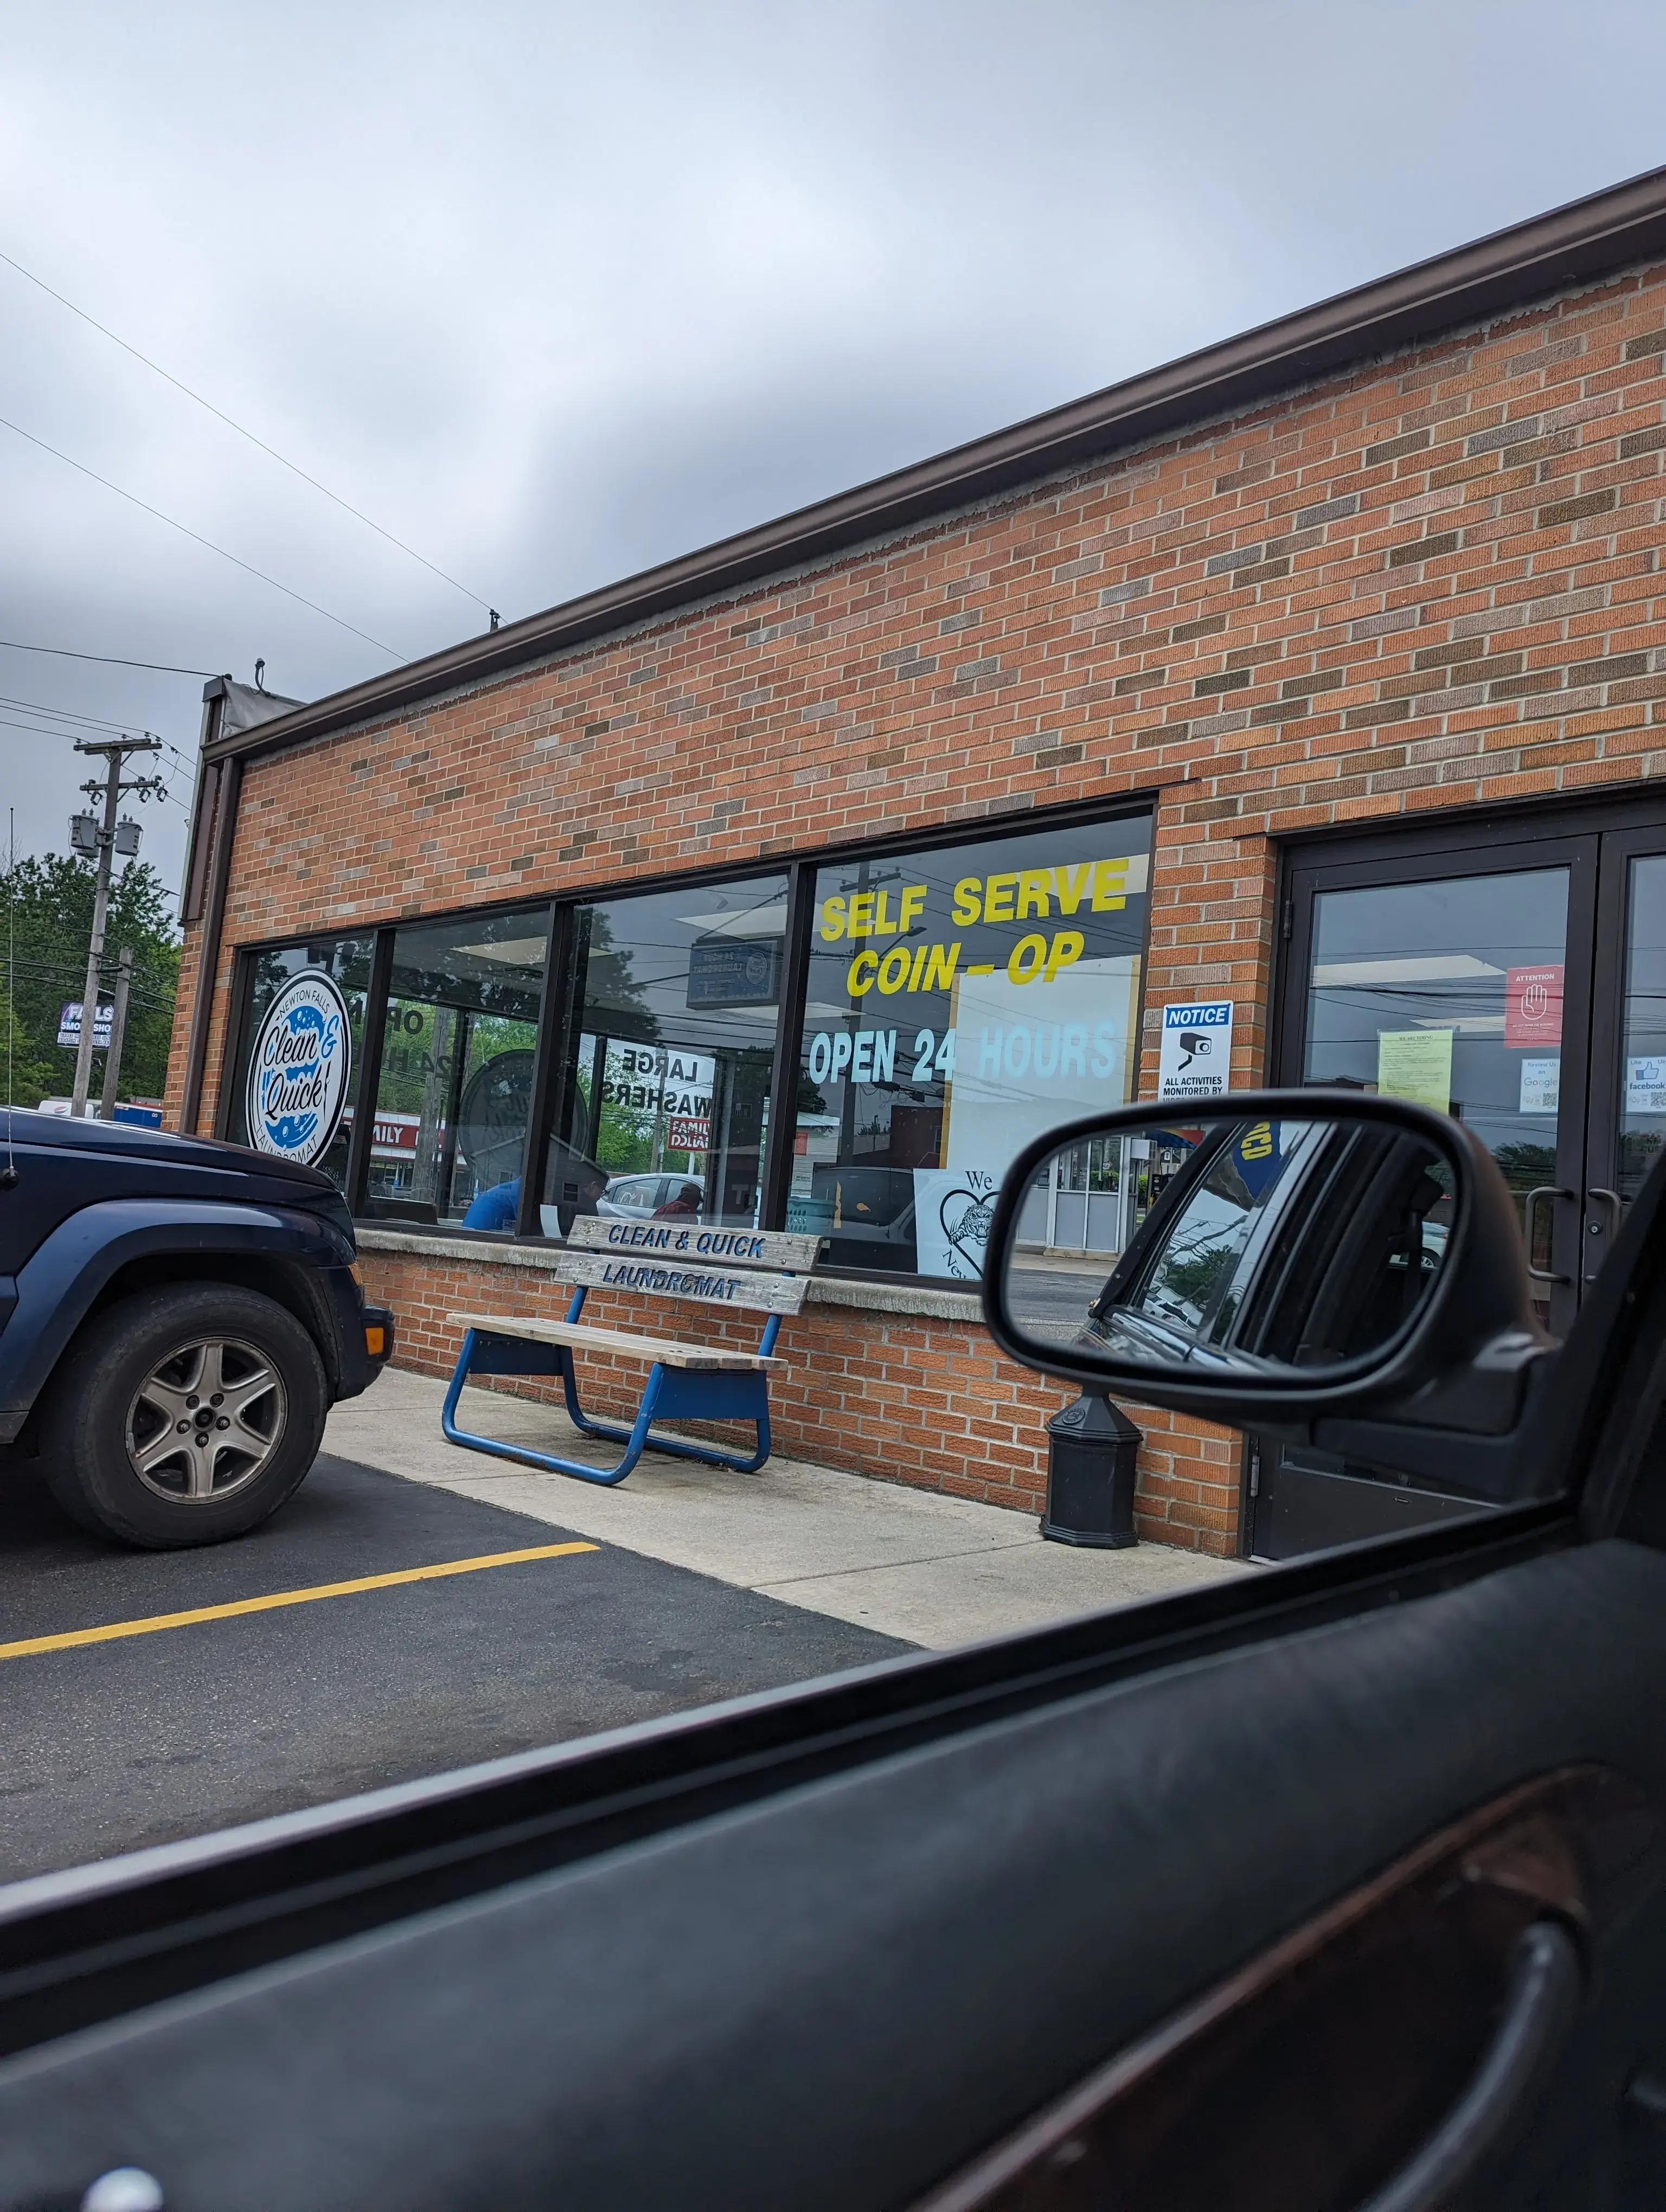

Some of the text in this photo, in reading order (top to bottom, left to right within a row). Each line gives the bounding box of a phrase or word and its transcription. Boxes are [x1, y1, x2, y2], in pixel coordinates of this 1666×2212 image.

[821, 858, 1130, 941] SELF SERVE
[847, 942, 962, 997] COIN
[1008, 931, 1085, 986] OP
[1516, 974, 1554, 982] ATTENTION
[279, 989, 330, 1019] NEWTON FALLS
[1169, 1008, 1227, 1025] NOTICE
[61, 1022, 112, 1032] SMO SHO
[264, 1014, 339, 1066] Clean &
[809, 1019, 1117, 1084] OPEN 24 HOURS
[1181, 1077, 1222, 1085] ACTIVITIES
[1524, 1077, 1558, 1088] Google
[1163, 1086, 1222, 1096] MONITORED BY
[672, 1121, 710, 1136] FAMIL
[671, 1134, 709, 1149] DOLLA
[965, 1171, 993, 1190] We
[608, 1225, 766, 1258] CLEAN & QUICK
[603, 1264, 742, 1300] LAUNDROMAT
